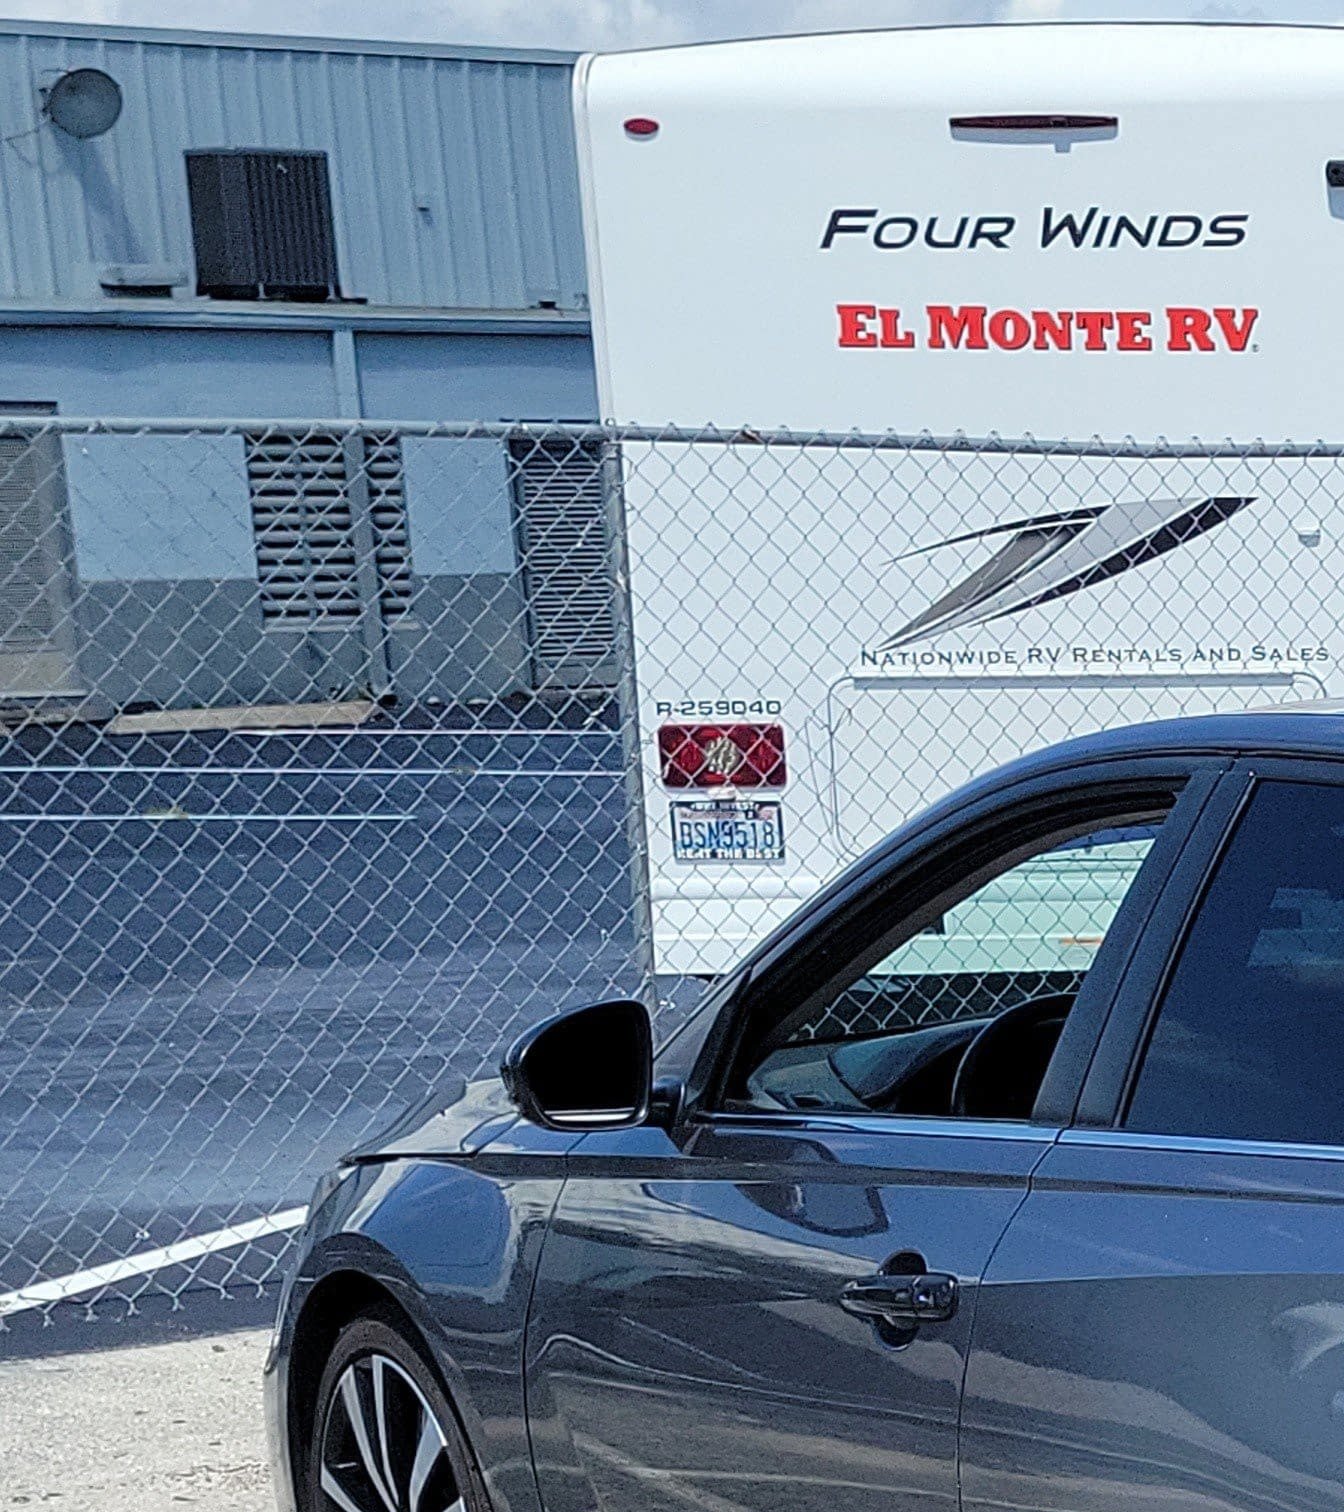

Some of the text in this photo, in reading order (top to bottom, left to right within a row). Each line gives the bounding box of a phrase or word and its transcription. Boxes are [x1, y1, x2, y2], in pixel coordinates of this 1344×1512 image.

[819, 206, 1249, 250] FOUR WINDS
[836, 303, 1258, 352] EL MONTE RV
[860, 645, 1329, 667] NATIONWIDE RV RENTALS AND SALES
[656, 700, 782, 716] R-259040
[680, 820, 775, 848] BSN9518
